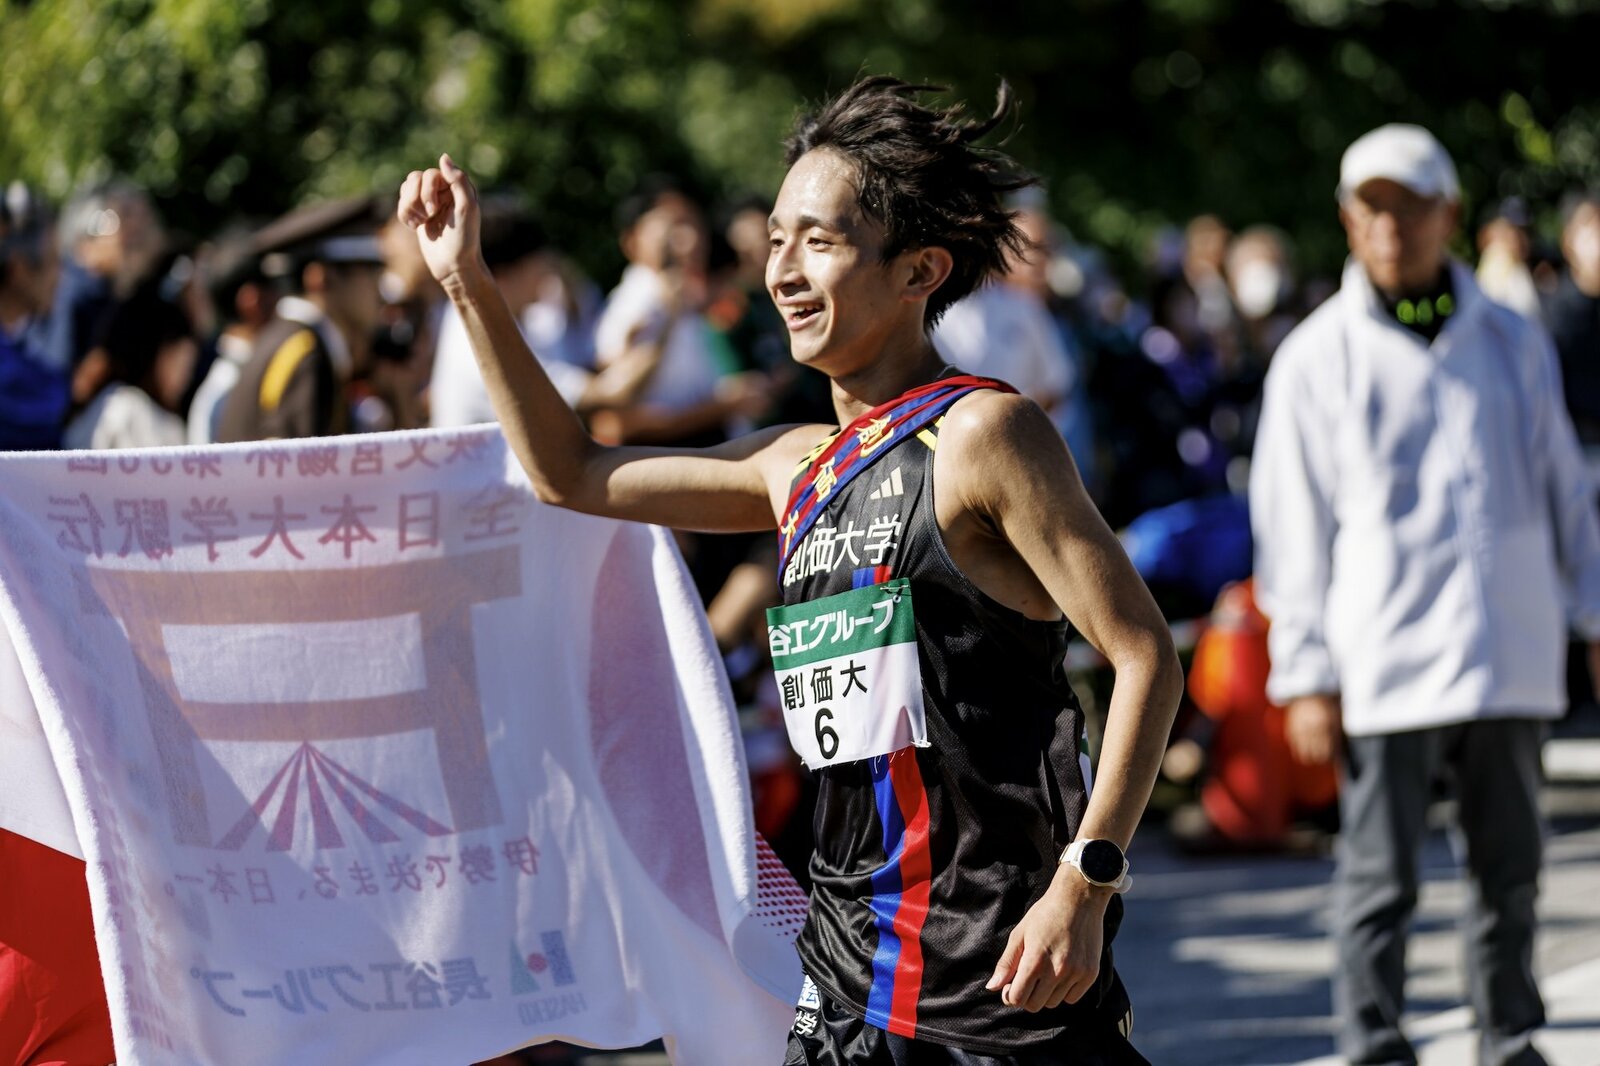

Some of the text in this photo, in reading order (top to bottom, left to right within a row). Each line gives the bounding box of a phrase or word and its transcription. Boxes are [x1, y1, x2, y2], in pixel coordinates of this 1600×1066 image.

[781, 660, 868, 710] 創価大
[815, 708, 839, 760] 6
